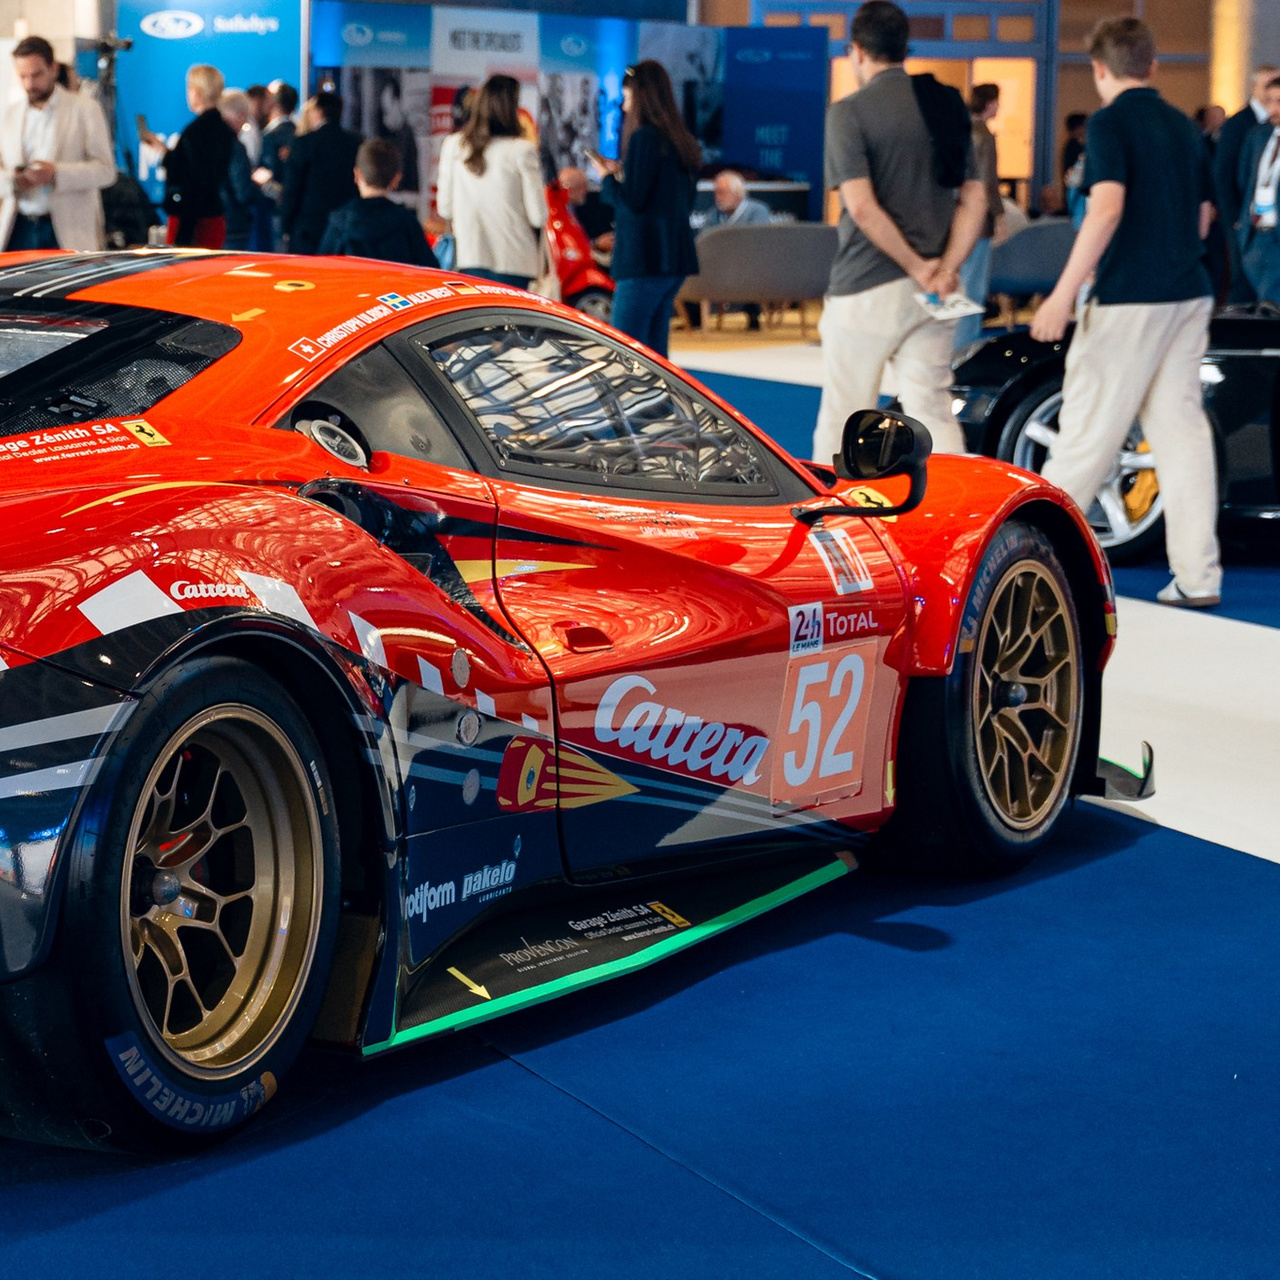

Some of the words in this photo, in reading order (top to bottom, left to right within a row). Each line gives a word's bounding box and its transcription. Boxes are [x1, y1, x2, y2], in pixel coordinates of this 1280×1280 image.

[316, 315, 366, 348] CHRISTOPH
[15, 447, 48, 459] Dealer
[48, 439, 96, 453] Lausanne
[108, 434, 130, 443] Sion
[30, 426, 91, 445] Zénith
[91, 423, 120, 435] SA
[33, 442, 140, 464] www.ferrari-zenith.ch
[818, 536, 870, 586] AM
[170, 580, 250, 600] Carrera
[794, 608, 822, 642] 24h
[594, 675, 770, 786] Carrera
[783, 653, 865, 786] 52
[461, 859, 516, 901] pakelo
[568, 914, 608, 931] Garage
[601, 907, 638, 923] Zénith
[632, 904, 652, 916] SA
[119, 1046, 237, 1126] MICHELIN
